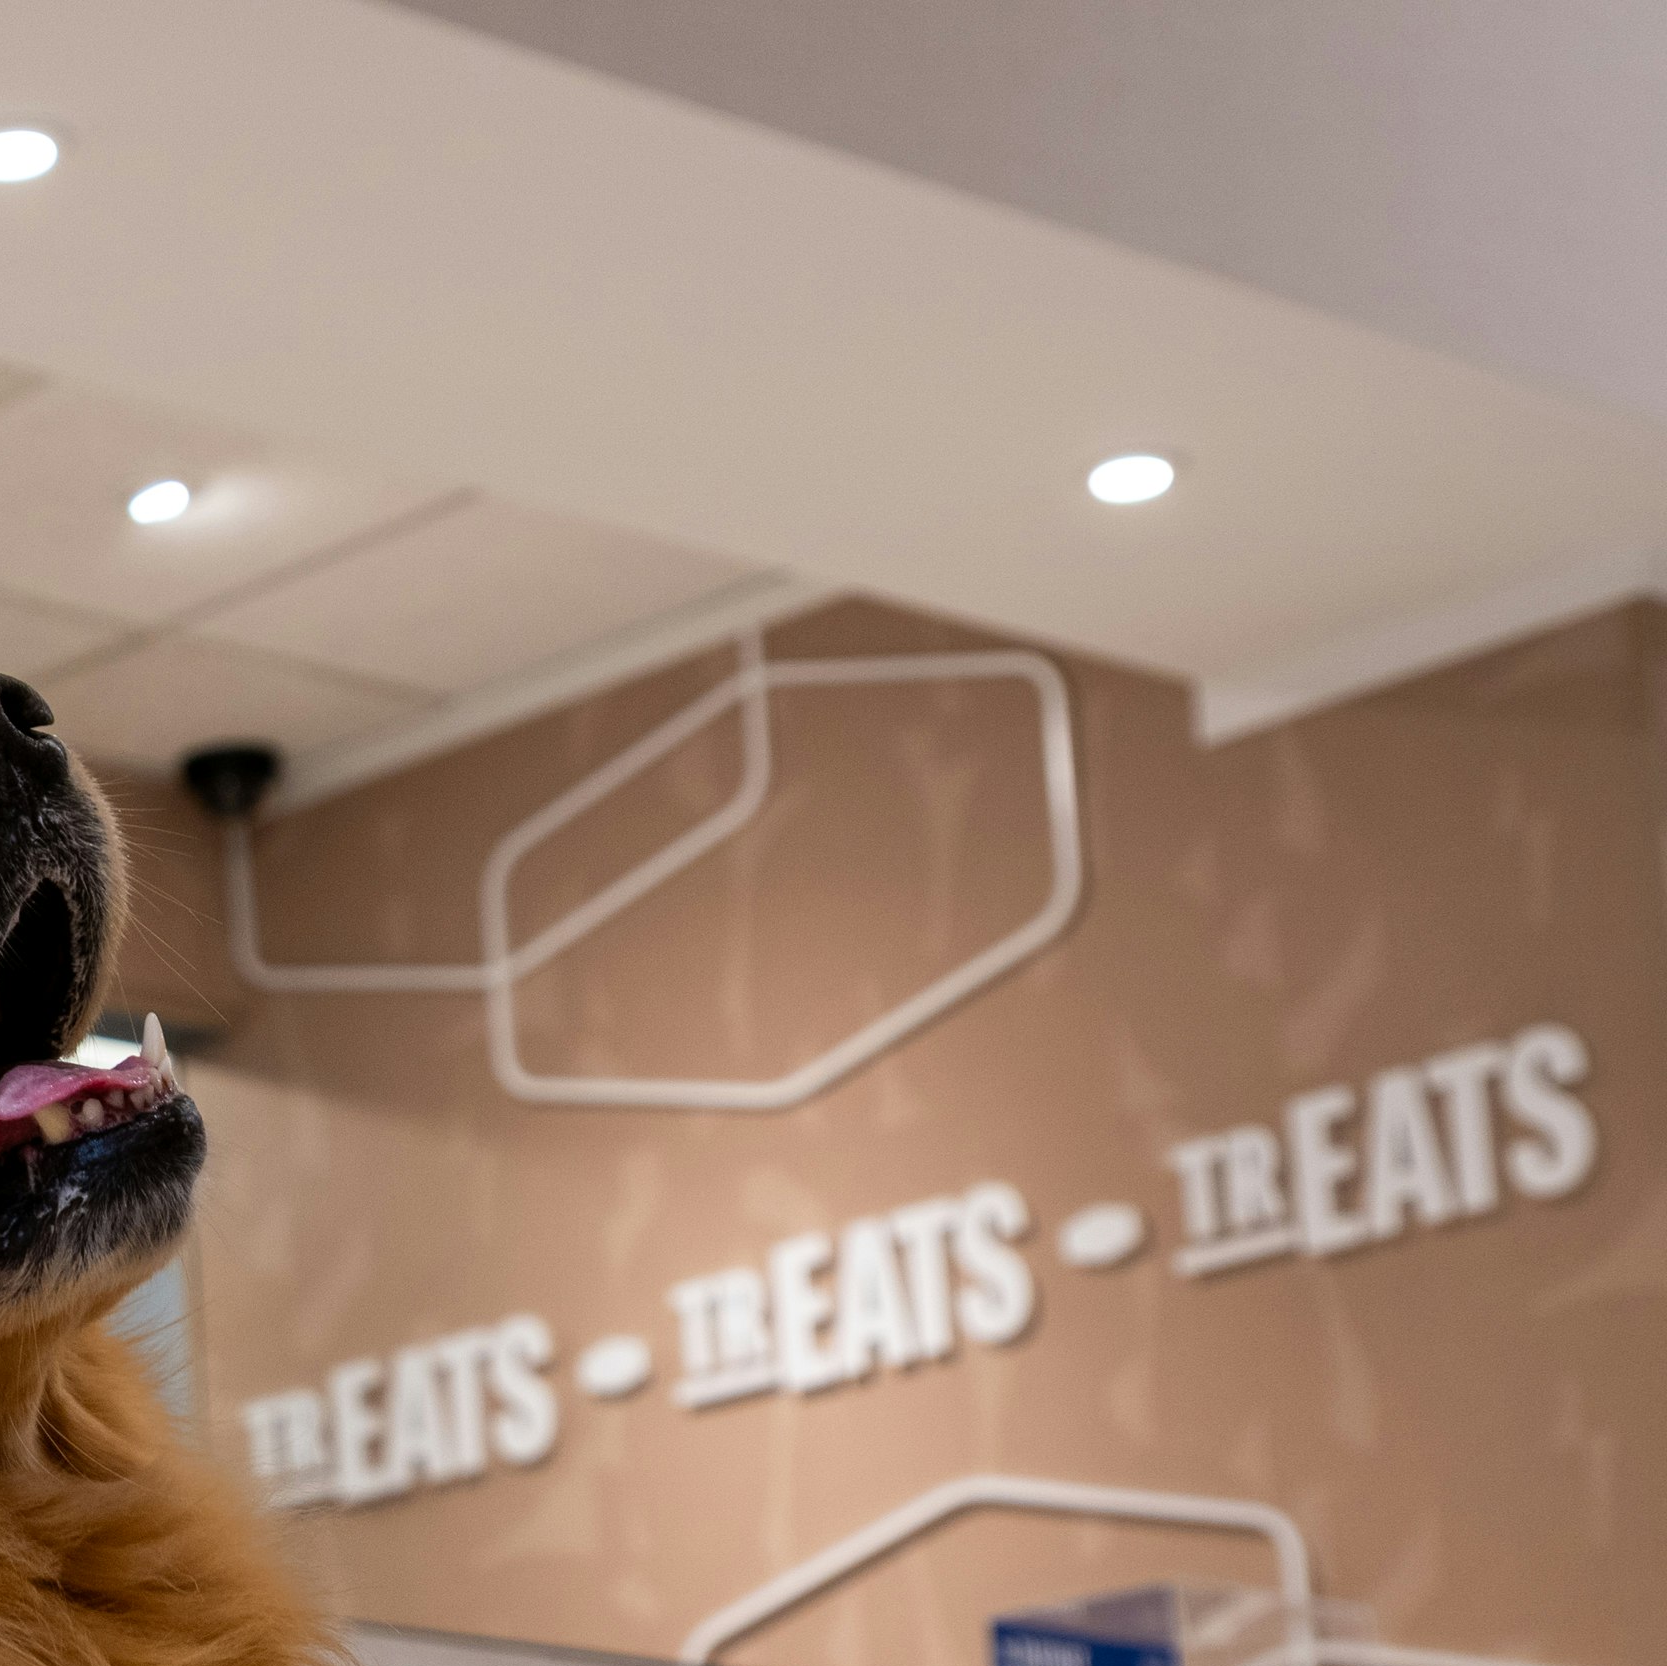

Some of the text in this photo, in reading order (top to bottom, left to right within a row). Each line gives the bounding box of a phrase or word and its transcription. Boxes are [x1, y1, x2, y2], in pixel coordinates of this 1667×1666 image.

[243, 1020, 1597, 1506] TREATS TREATS TREATS
